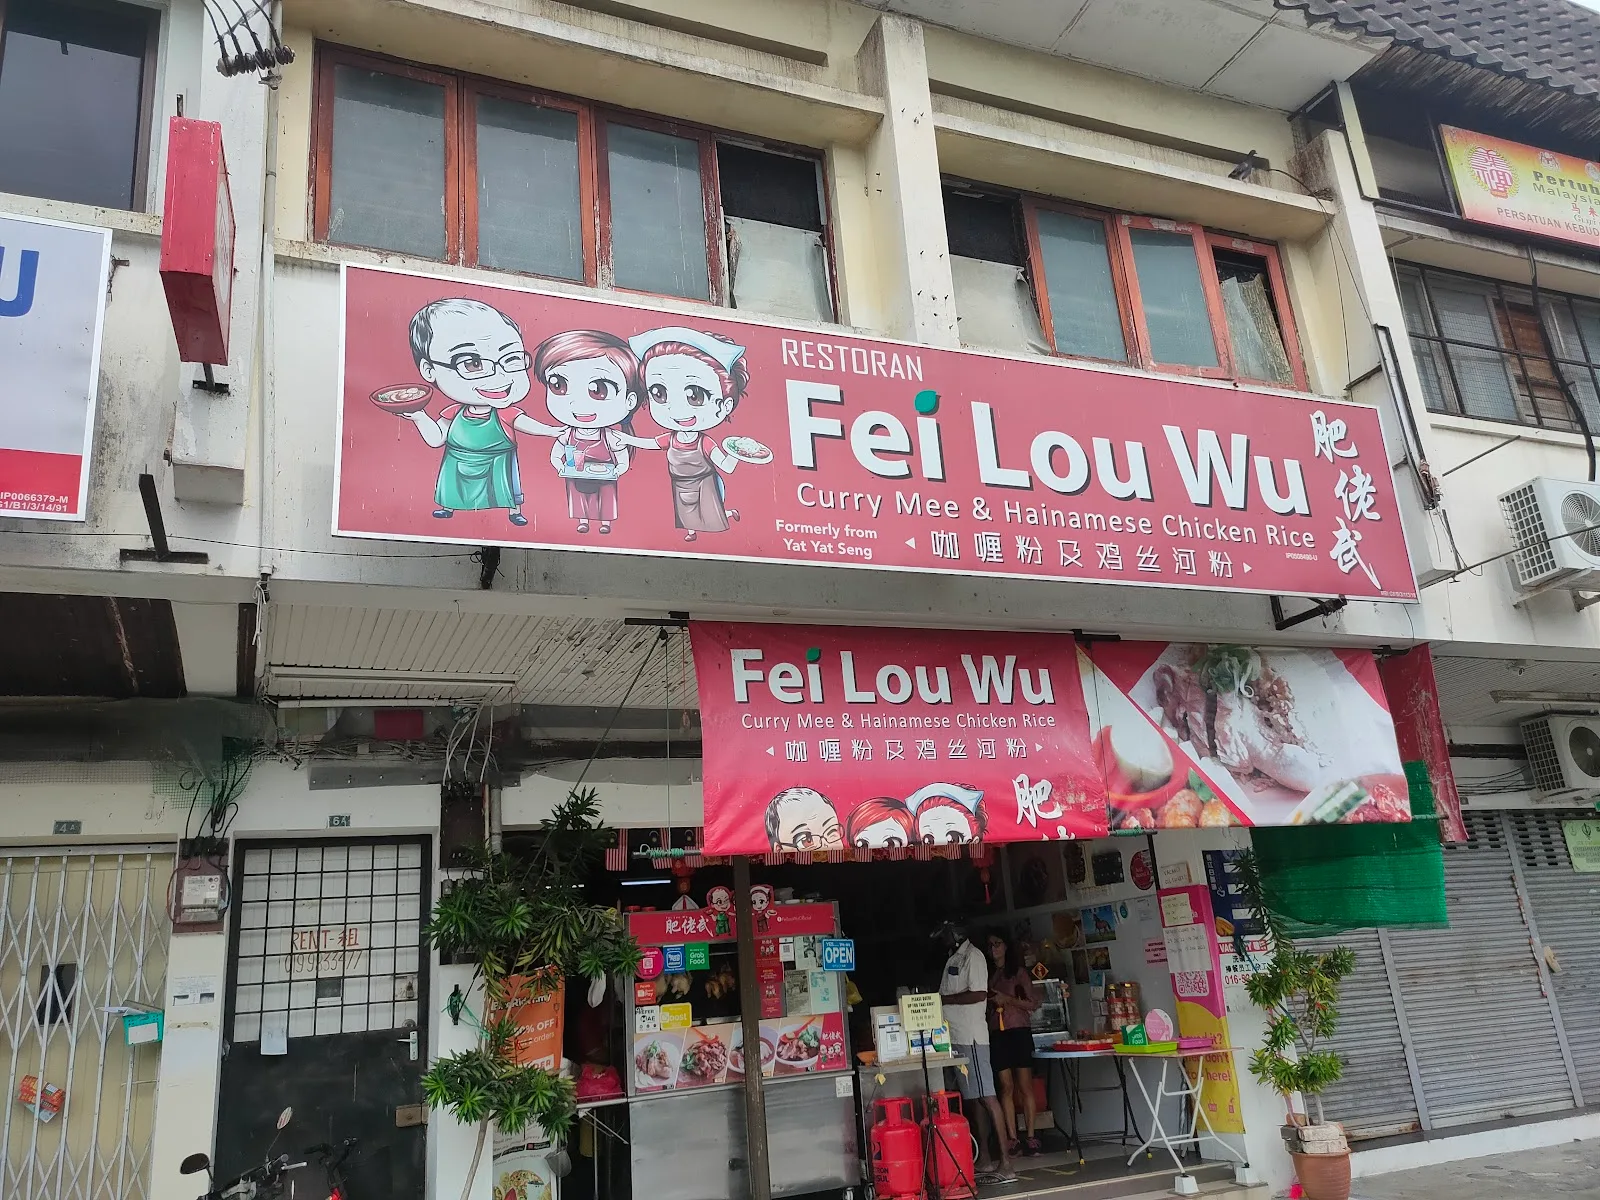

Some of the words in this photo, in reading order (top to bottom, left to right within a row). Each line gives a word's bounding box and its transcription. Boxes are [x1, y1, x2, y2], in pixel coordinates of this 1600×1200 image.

[1532, 182, 1600, 205] Malaysia
[1496, 207, 1561, 229] PERSATUAN
[781, 338, 924, 382] RESTORAN
[786, 379, 945, 481] Fei
[971, 401, 1154, 501] Lou
[1162, 425, 1312, 517] Wu
[0, 491, 69, 504] IP0066379-M
[1310, 410, 1382, 590] 肥佬武
[797, 482, 882, 517] Curry
[896, 490, 959, 518] Mee
[972, 496, 994, 521] &
[1004, 500, 1152, 534] Hainamese
[1162, 514, 1258, 543] Chicken
[1266, 525, 1316, 548] Rice
[775, 519, 840, 539] Formerly
[844, 524, 877, 539] from
[783, 537, 807, 552] Yat
[810, 539, 835, 554] Yat
[838, 541, 873, 560] Seng
[730, 647, 823, 704] Fei
[840, 651, 952, 705] Lou
[961, 654, 1055, 705] Wu
[741, 713, 790, 732] Curry
[797, 713, 835, 729] Mee
[841, 713, 855, 729] &
[860, 713, 951, 729] Hainamese
[956, 713, 1018, 729] Chicken
[1023, 713, 1056, 729] Rice
[825, 946, 853, 964] OPEN
[537, 1019, 555, 1031] OFF
[534, 1032, 555, 1043] orders
[1205, 1068, 1231, 1081] here!
